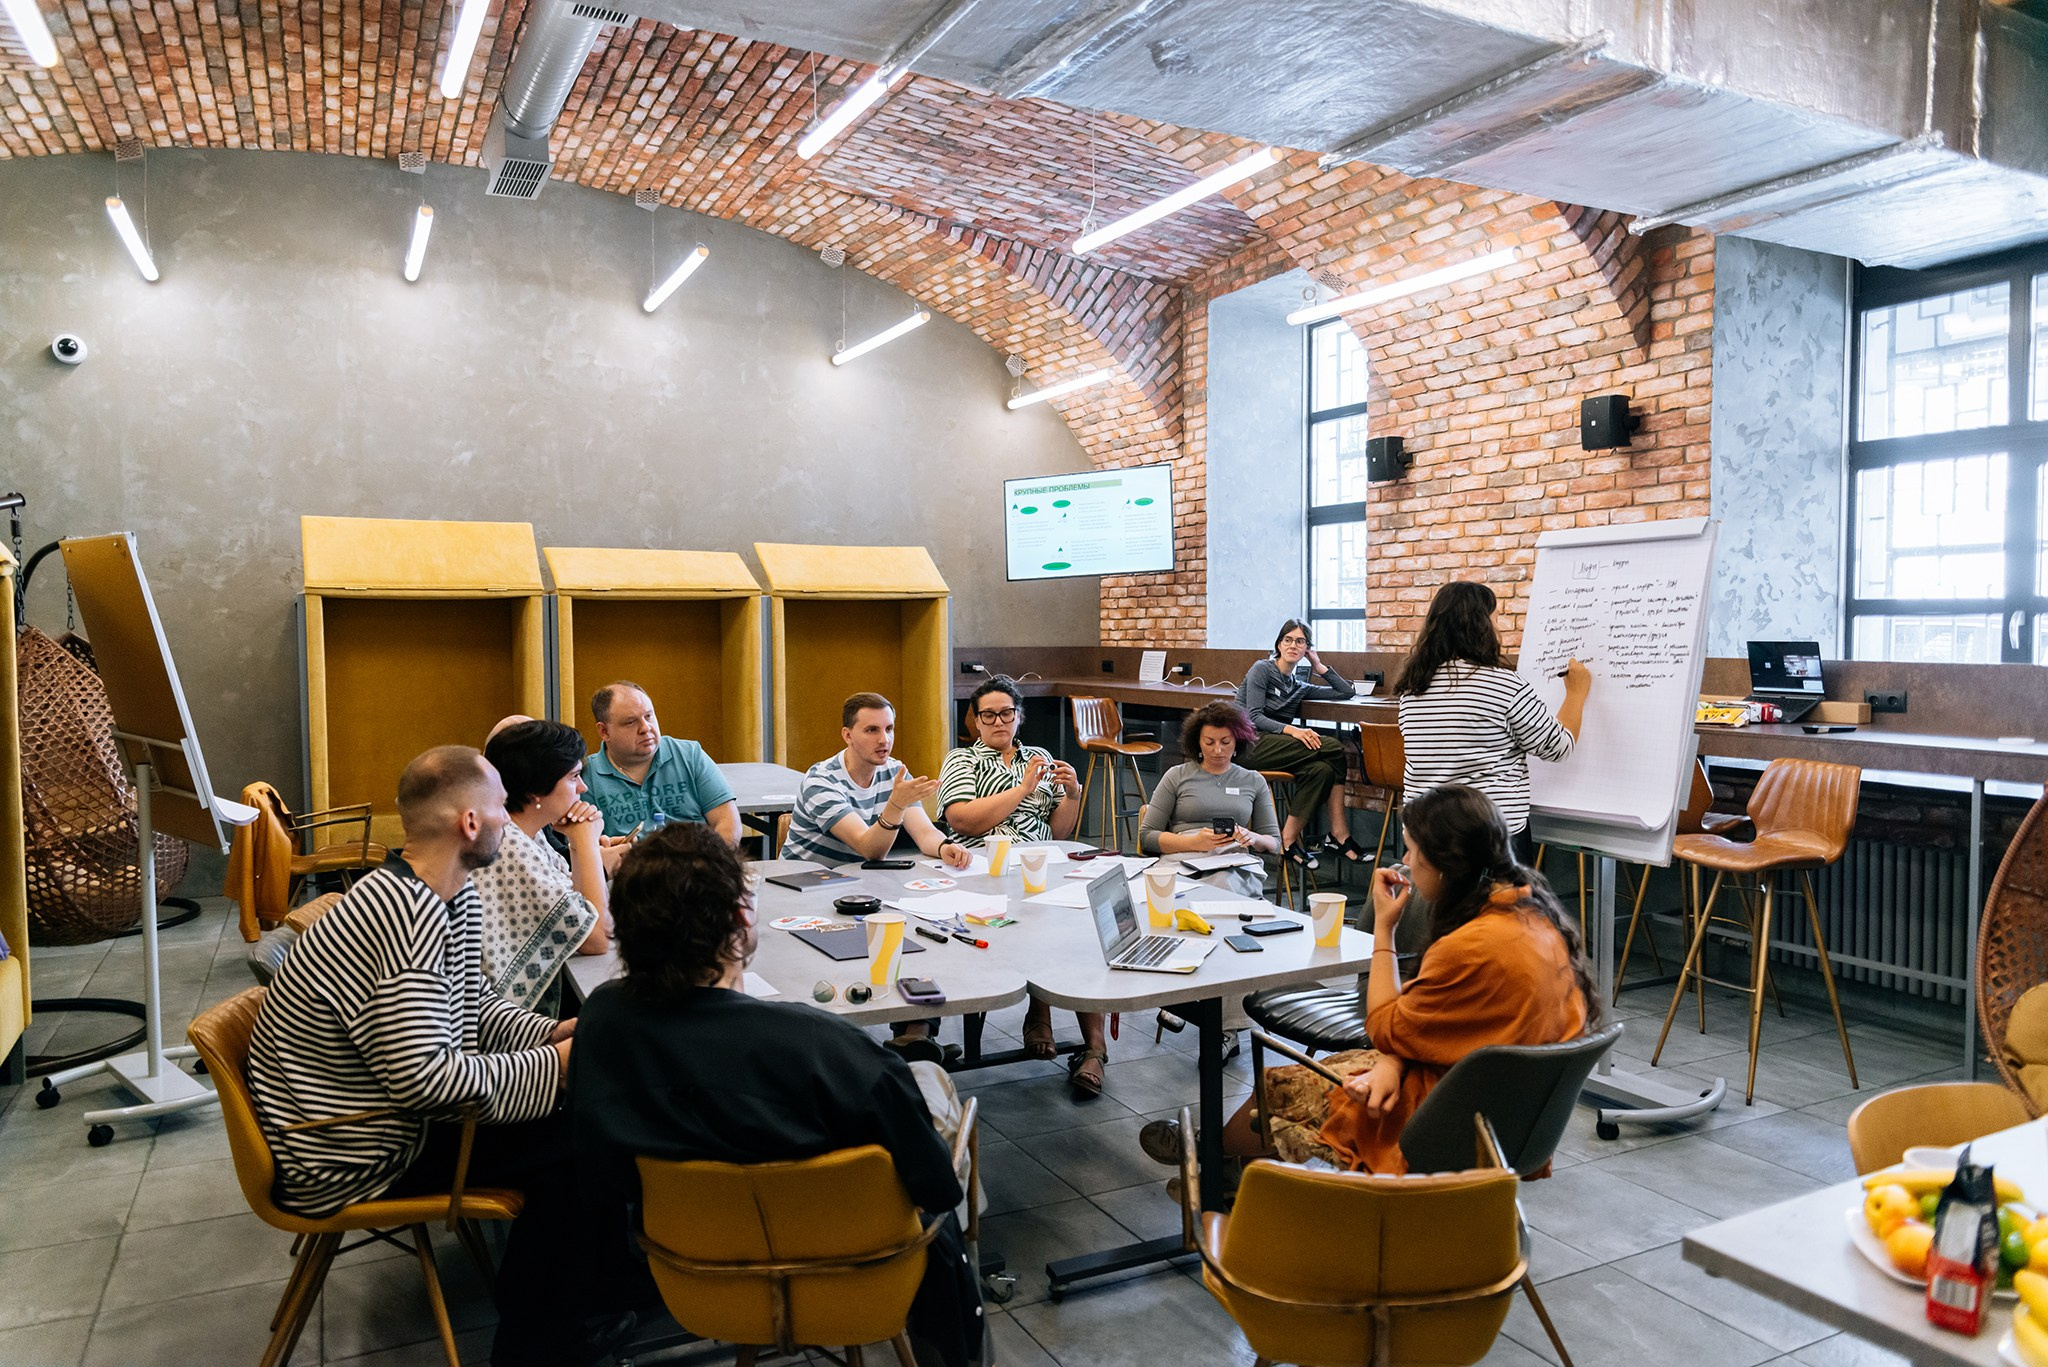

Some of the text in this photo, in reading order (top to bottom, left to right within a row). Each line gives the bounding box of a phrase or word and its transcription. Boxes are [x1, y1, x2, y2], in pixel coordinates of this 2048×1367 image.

[1014, 483, 1091, 495] КРУПНЫЕ ПРОБЛЕМЫ
[597, 781, 687, 808] EXPLORE
[606, 796, 685, 816] WHERVER
[614, 811, 647, 826] YOU
